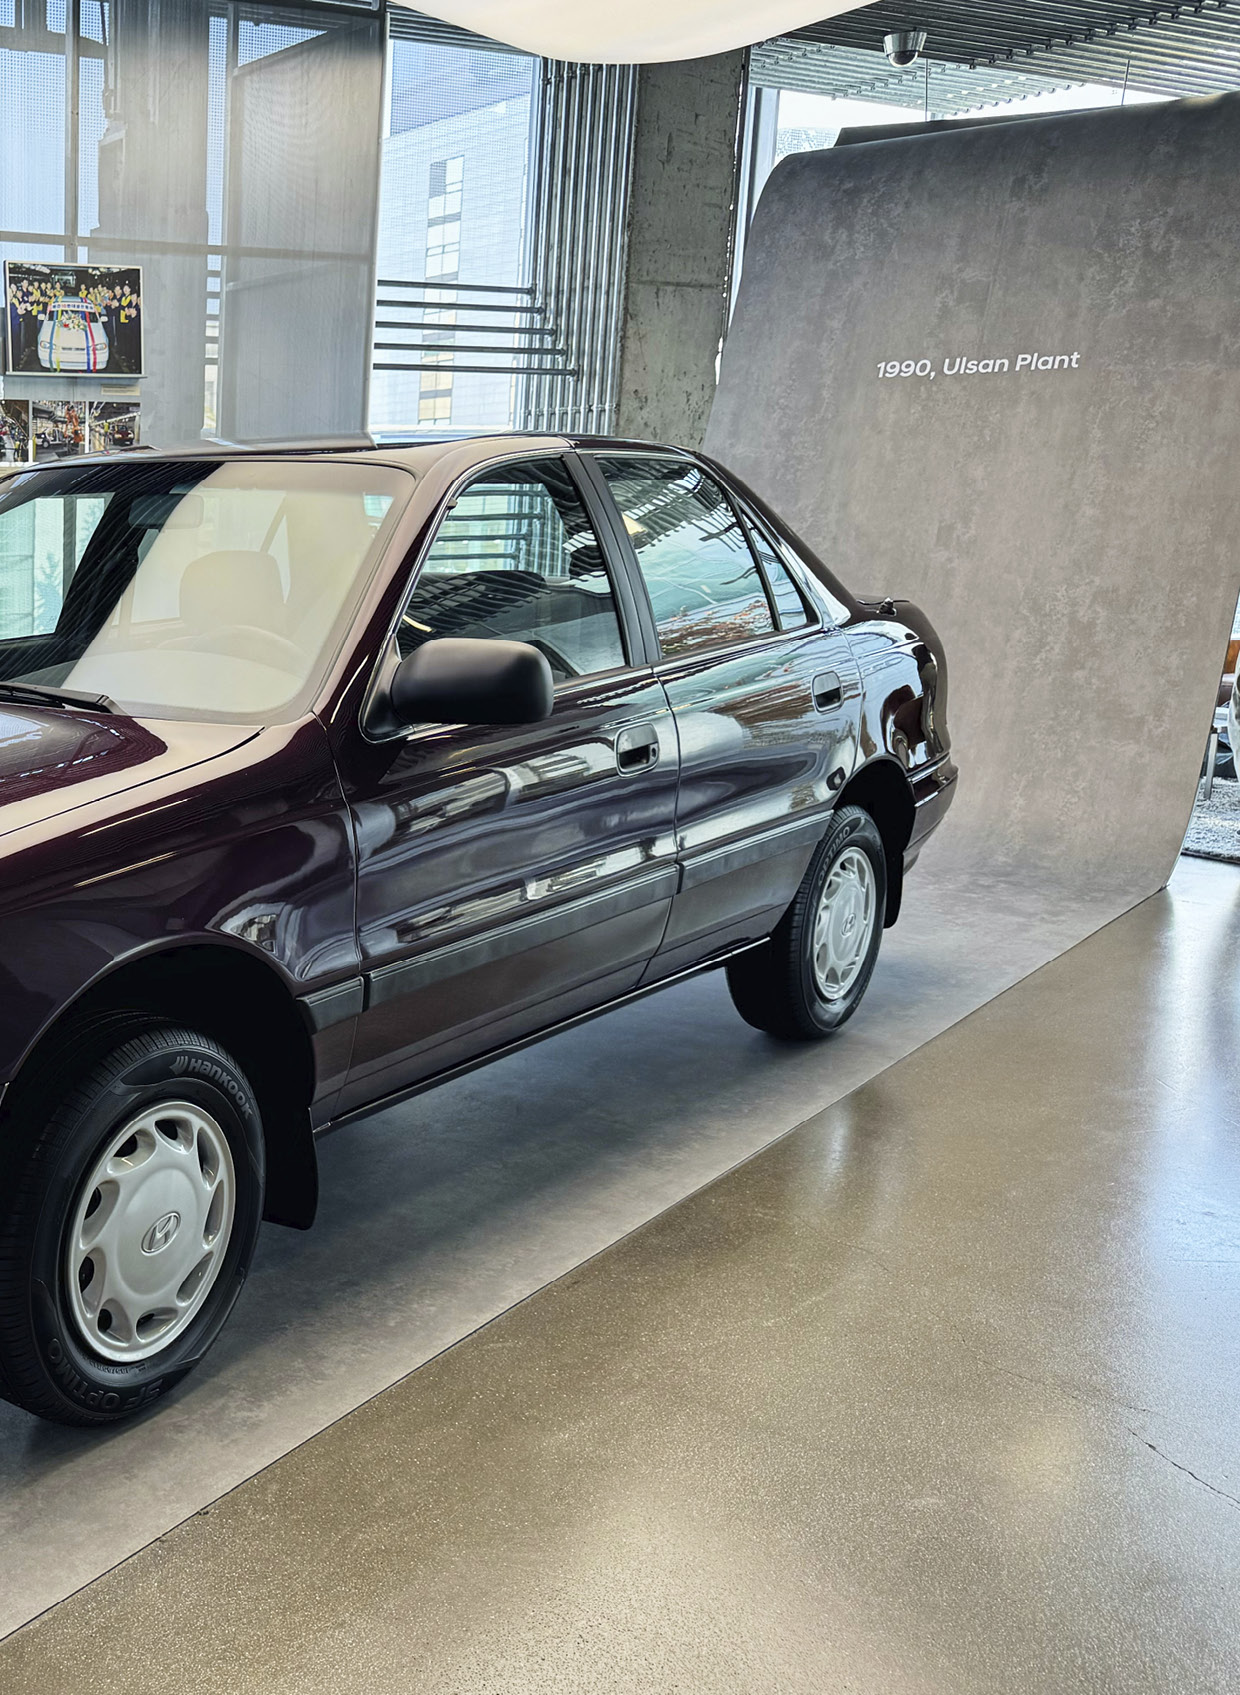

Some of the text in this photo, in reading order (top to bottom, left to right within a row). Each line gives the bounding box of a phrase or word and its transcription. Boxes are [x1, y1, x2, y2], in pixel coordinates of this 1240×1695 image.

[876, 351, 1080, 380] 1990, Ulsan Plant
